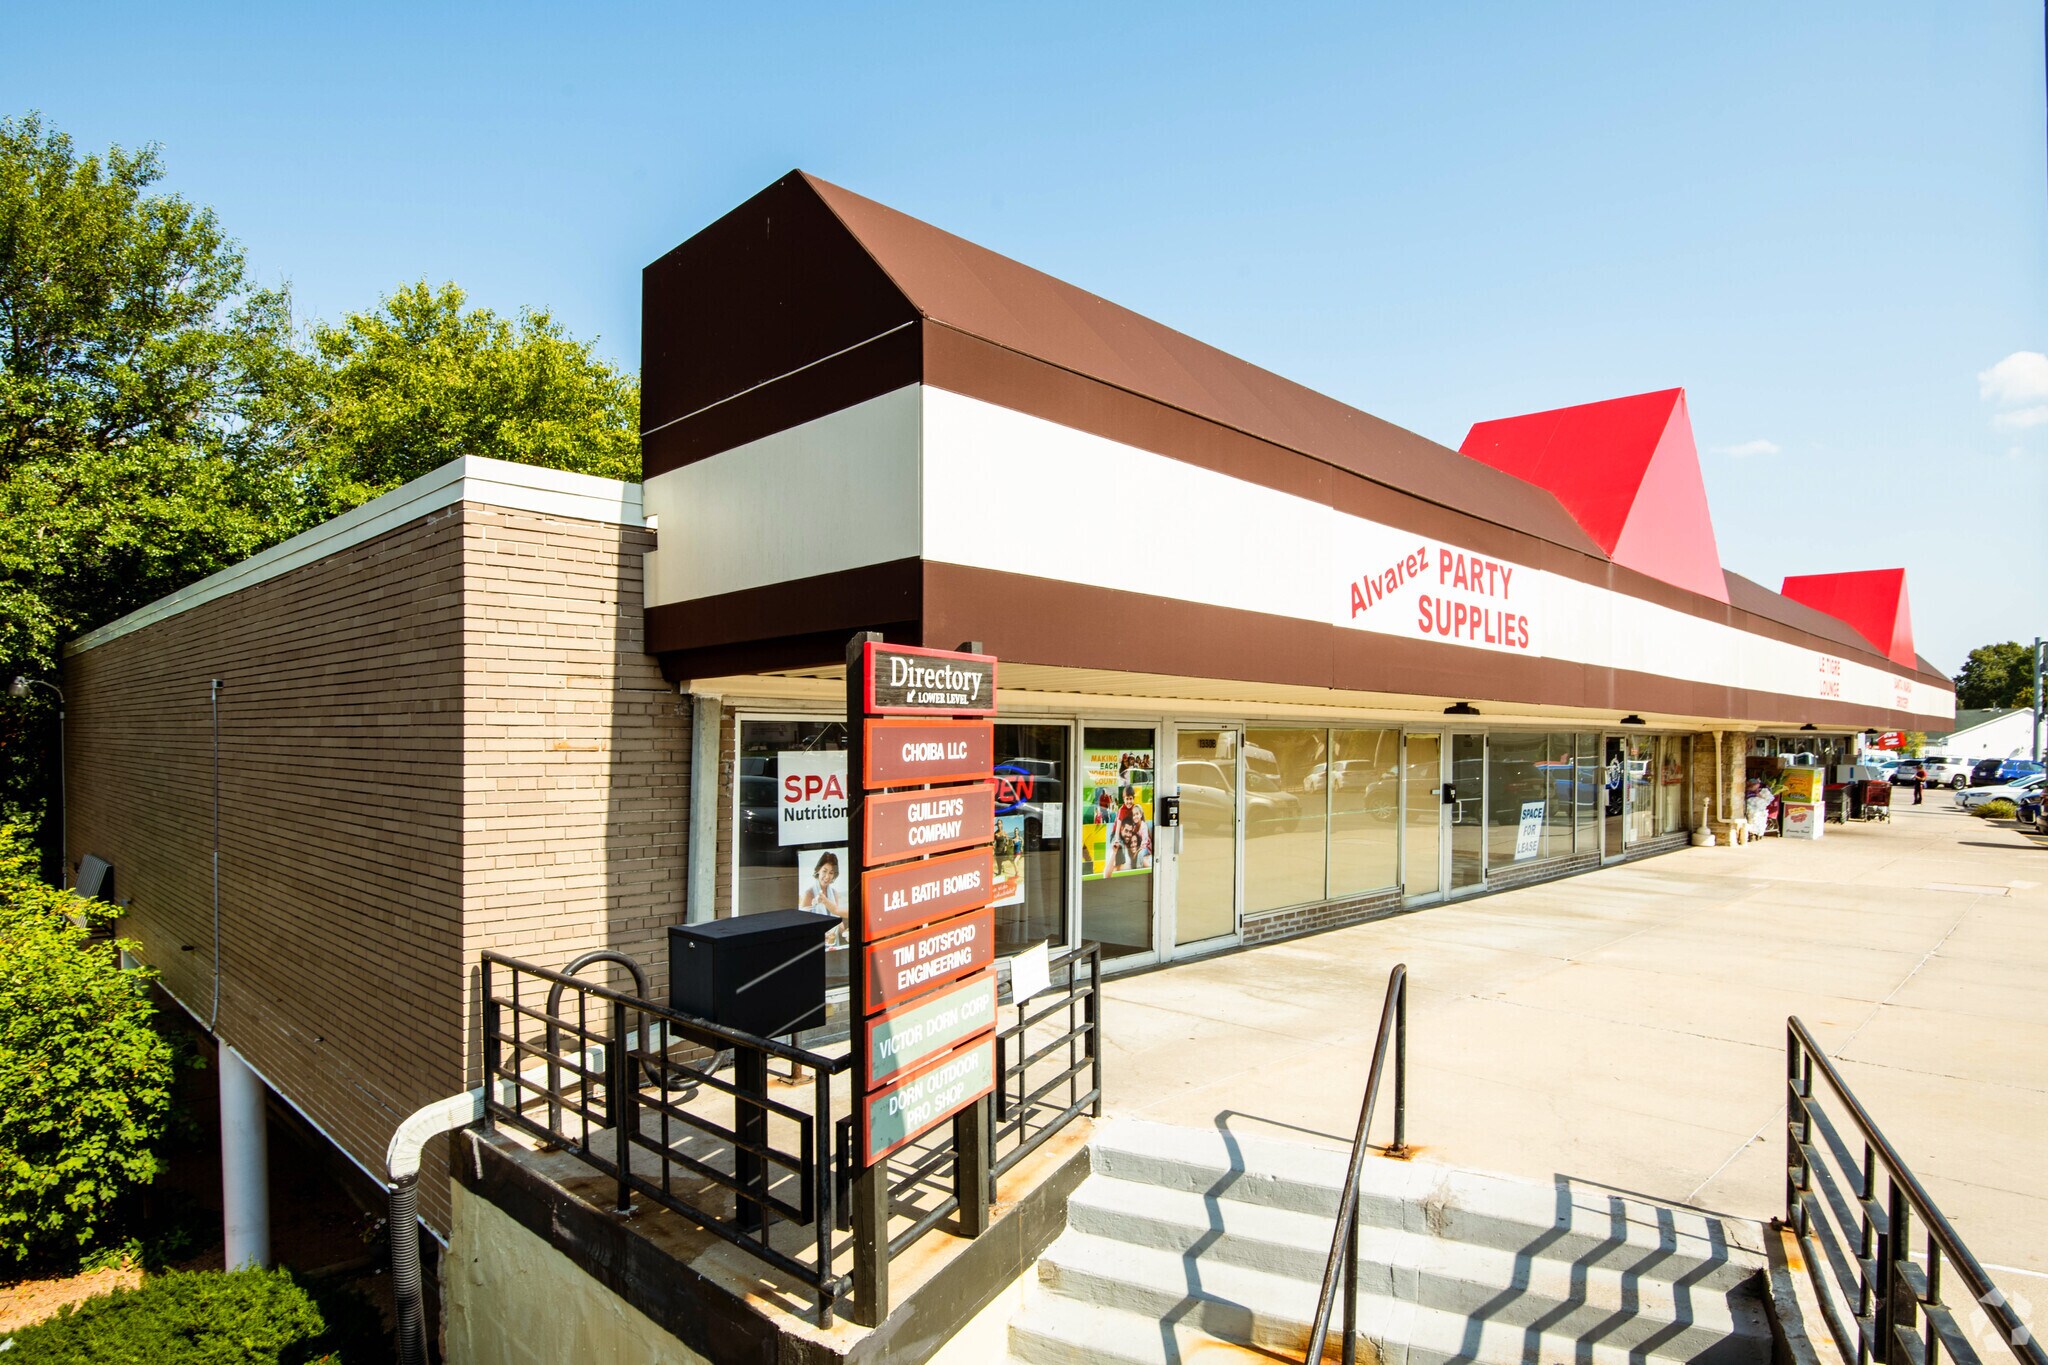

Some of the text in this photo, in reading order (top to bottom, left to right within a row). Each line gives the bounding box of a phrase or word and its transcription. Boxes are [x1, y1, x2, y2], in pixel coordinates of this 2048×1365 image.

[1351, 546, 1513, 619] Alvarez PARTY
[1418, 594, 1529, 649] SUPPLIES
[890, 656, 983, 700] Directory
[918, 691, 969, 705] LOWER LEVEL
[947, 742, 968, 760] LLC
[1091, 754, 1118, 762] MAKING
[784, 774, 848, 803] SPA
[784, 803, 848, 822] Nutrition
[908, 798, 964, 822] GUILLEN'S
[1521, 807, 1543, 820] SPACE
[908, 821, 962, 846] COMPANY
[1523, 824, 1536, 836] FOR
[1517, 840, 1538, 854] LEASE
[884, 889, 909, 912] L&L
[911, 880, 940, 905] BATH
[943, 870, 981, 896] BOMBS
[893, 924, 976, 968] TIM BOTSFORD
[897, 947, 972, 990] ENGINEERING
[879, 993, 990, 1059] VICTOR DORN CORP
[888, 1053, 980, 1116] DORN OUTDOOR
[906, 1082, 964, 1130] PRO SHOP
